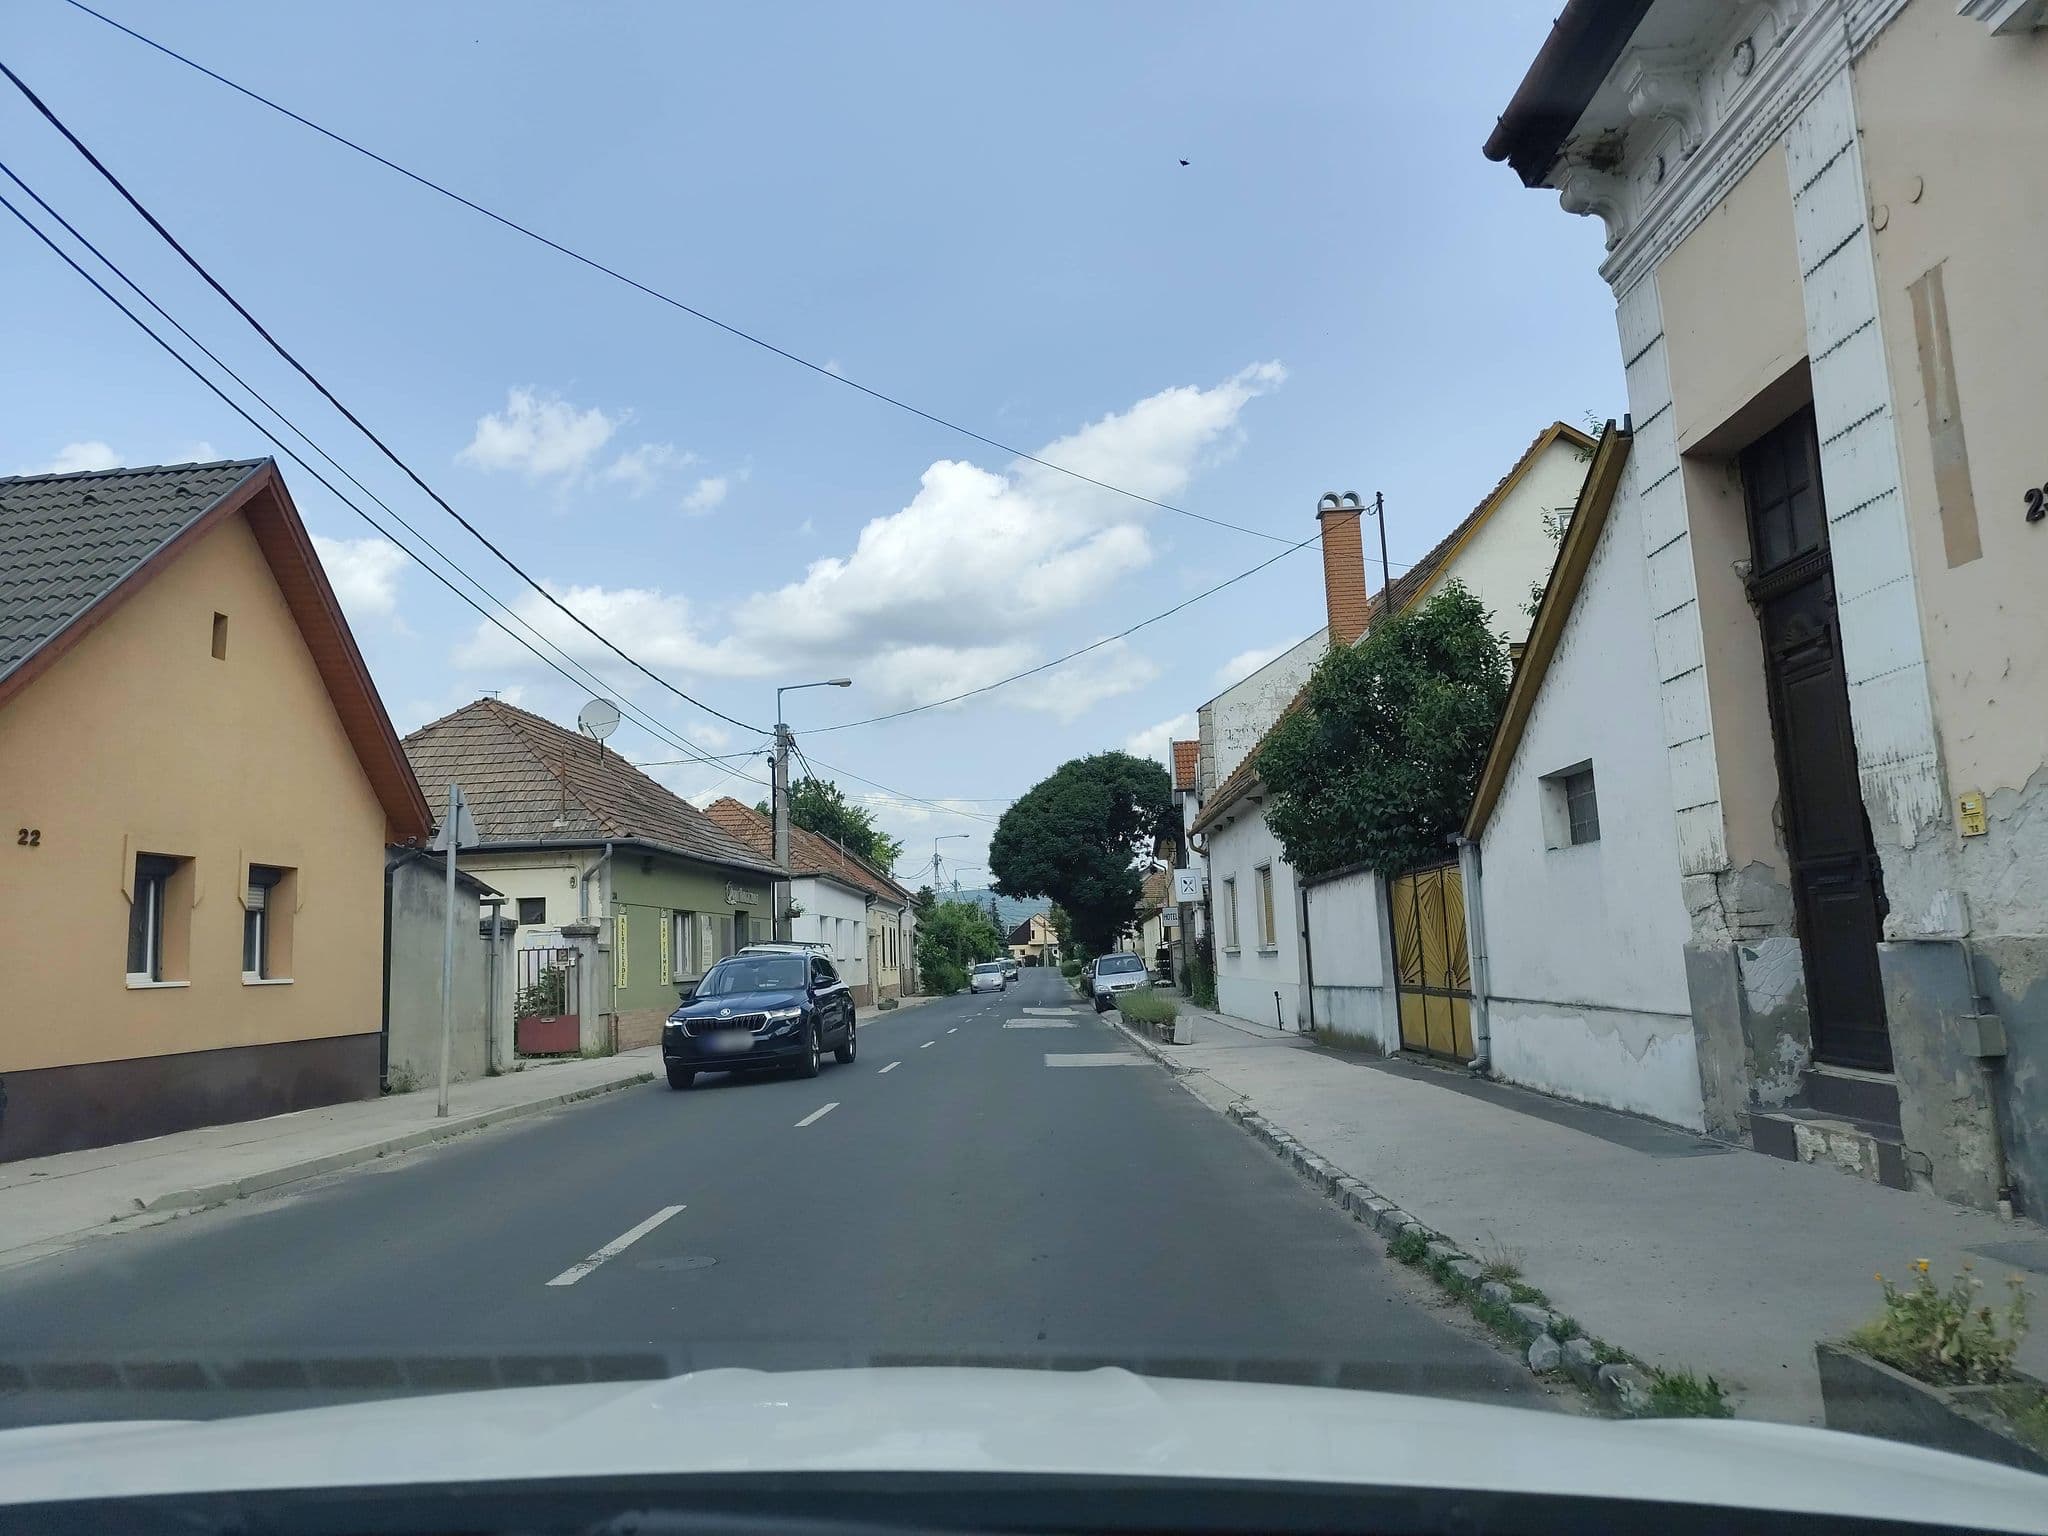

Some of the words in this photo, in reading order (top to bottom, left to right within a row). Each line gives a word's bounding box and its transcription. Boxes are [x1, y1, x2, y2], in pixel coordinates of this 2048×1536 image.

[2023, 481, 2048, 522] 2
[17, 828, 41, 847] 22
[1164, 913, 1178, 921] HOTEL
